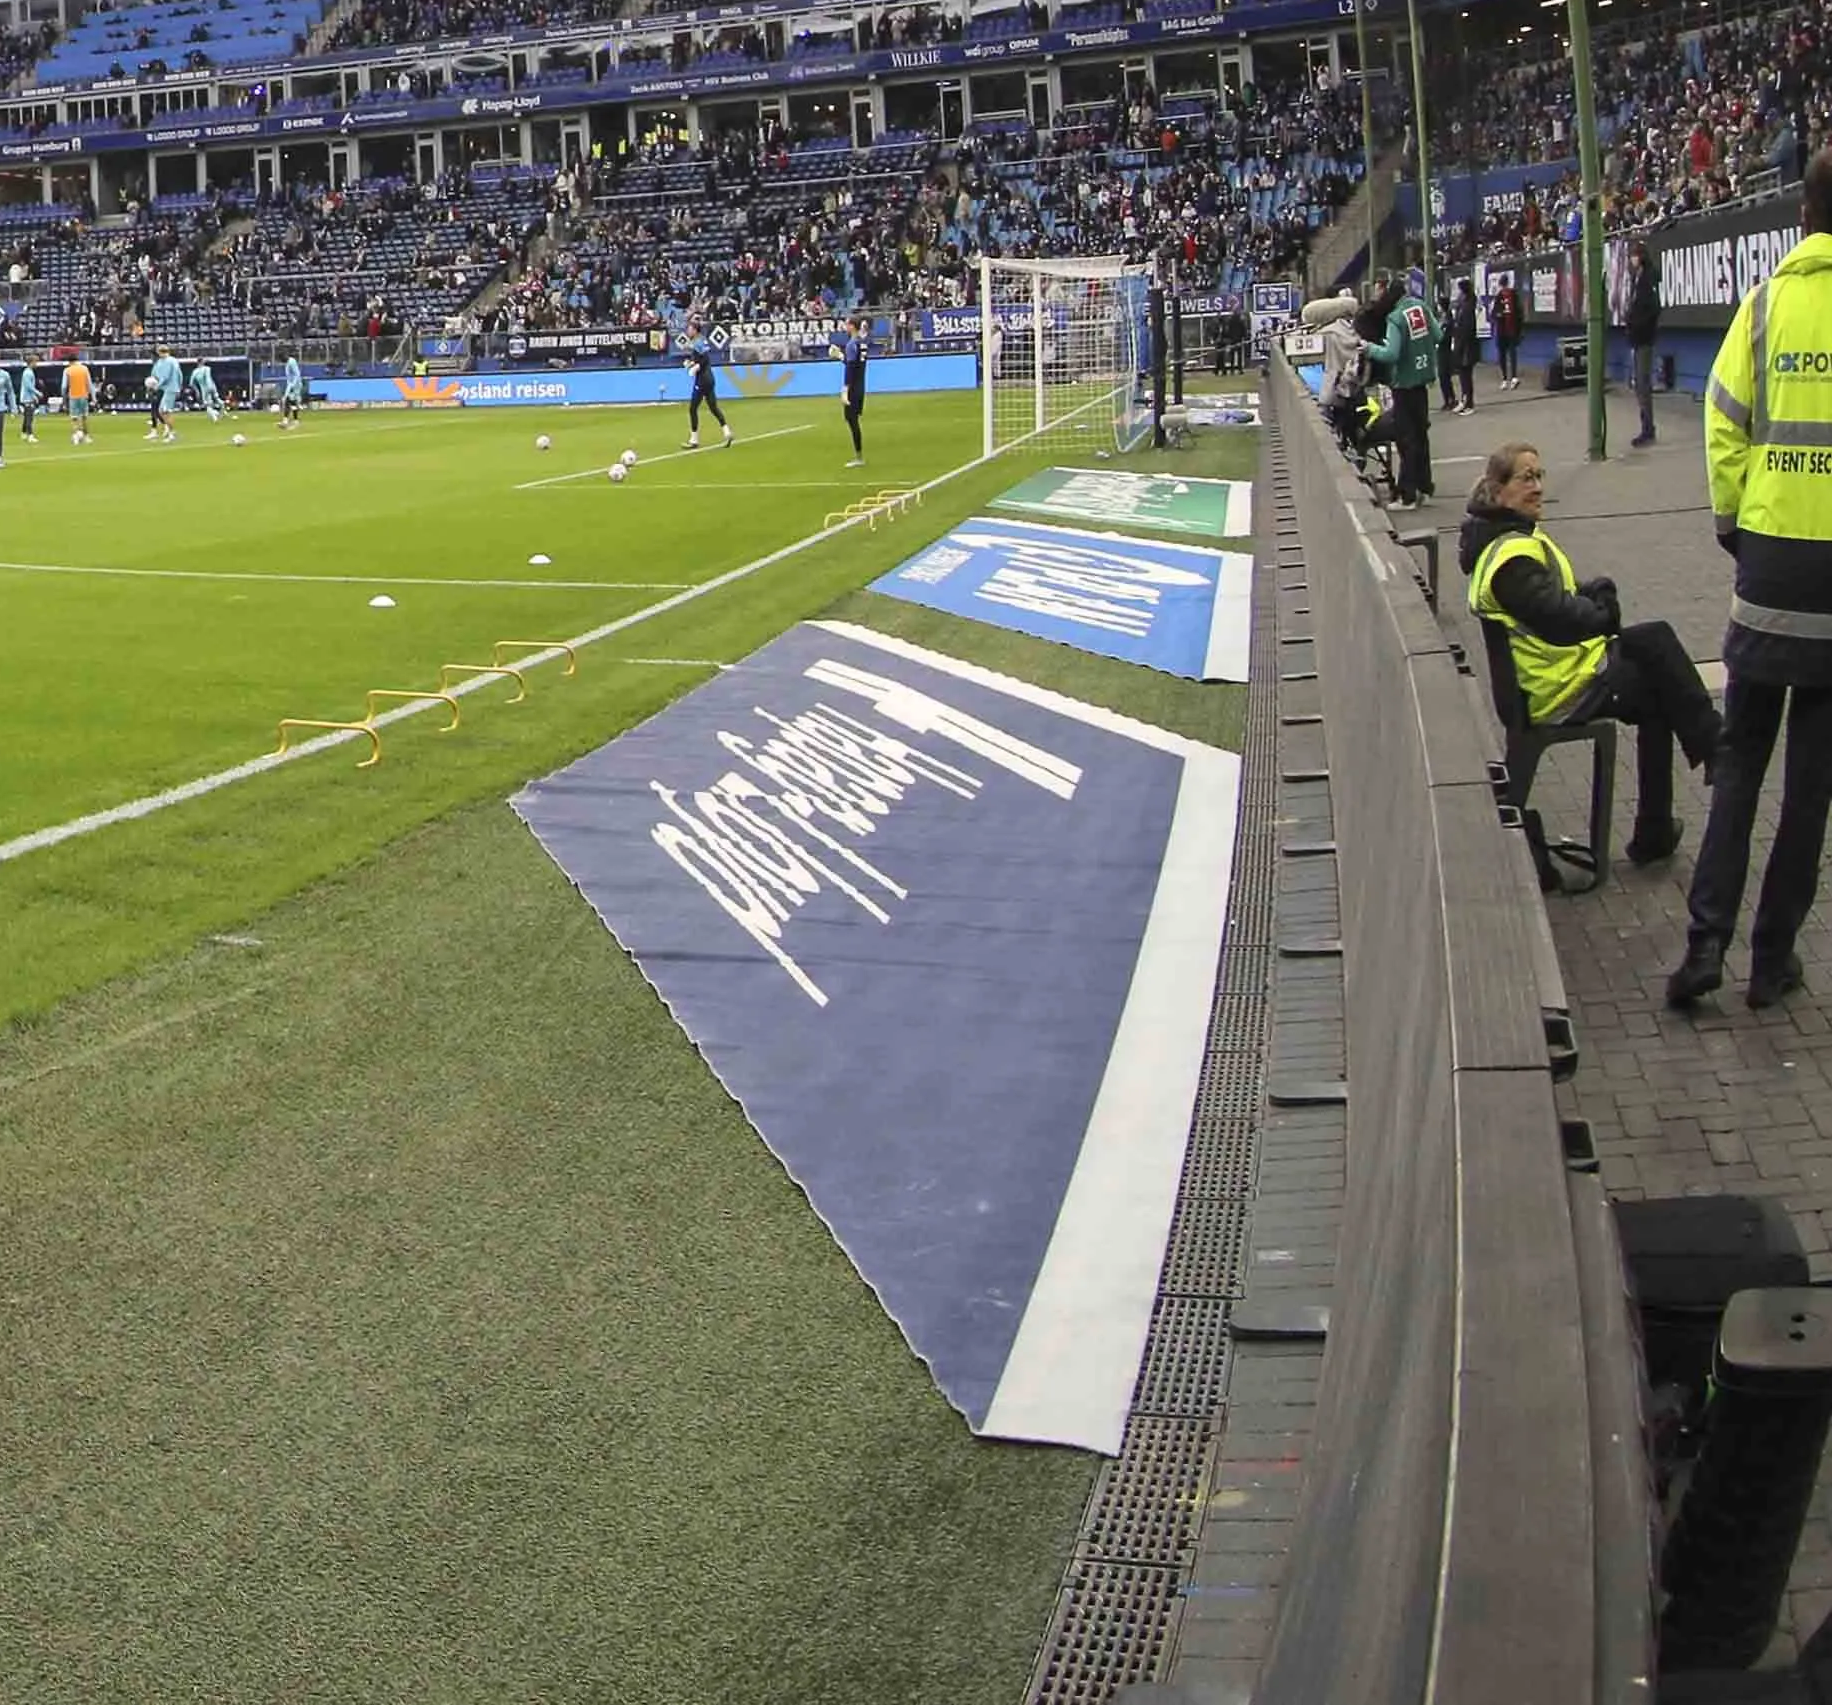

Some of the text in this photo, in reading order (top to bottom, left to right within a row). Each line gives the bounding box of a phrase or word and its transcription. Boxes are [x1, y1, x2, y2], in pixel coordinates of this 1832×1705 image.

[890, 49, 942, 68] WILLKIE
[482, 96, 541, 112] Hapag-Lloyd
[1658, 238, 1734, 307] JOHANNES
[517, 379, 567, 399] reisen
[1766, 450, 1807, 472] EVENT
